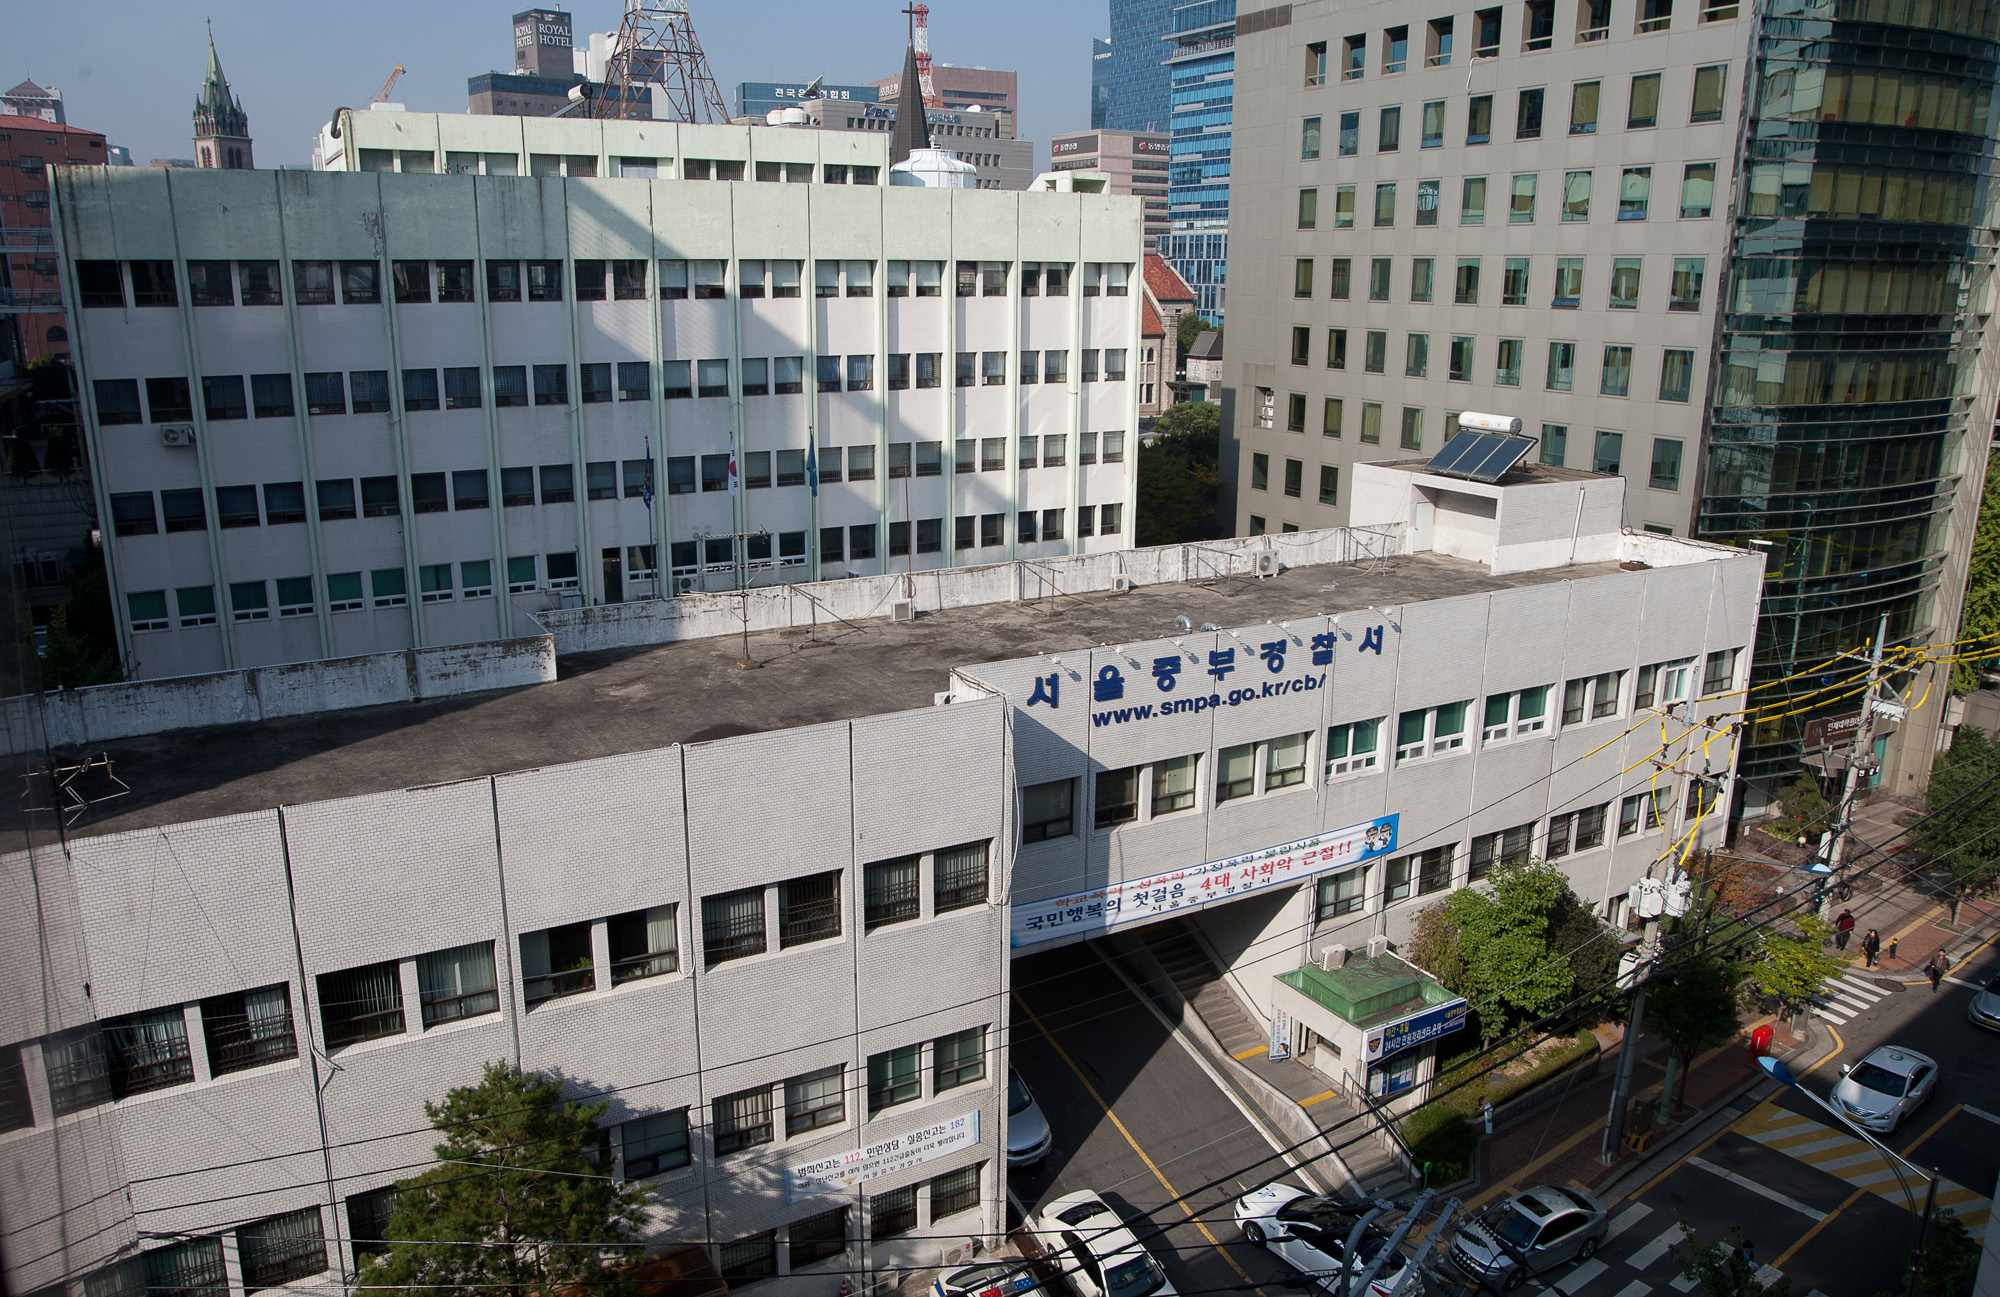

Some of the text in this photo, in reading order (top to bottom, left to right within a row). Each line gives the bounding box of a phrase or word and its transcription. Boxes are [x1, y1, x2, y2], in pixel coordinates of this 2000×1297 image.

[515, 24, 533, 38] ROYAL
[516, 35, 534, 48] HOTEL
[538, 23, 571, 36] ROYAL
[539, 34, 573, 47] HOTEL
[775, 88, 850, 100] 전국은연합회
[1027, 624, 1384, 709] 서울중부경찰서
[1092, 673, 1327, 728] www.smpa.go.kr/cb/
[1026, 839, 1352, 931] 국민행복의 첫걸음 4대 사회악 근절!!
[1055, 886, 1123, 907] 학교폭력
[1138, 871, 1185, 890] 성폭력
[1193, 854, 1255, 876] 가정폭력
[797, 1117, 966, 1178] 범죄신고는 112, 민원상담 실종신고는 182
